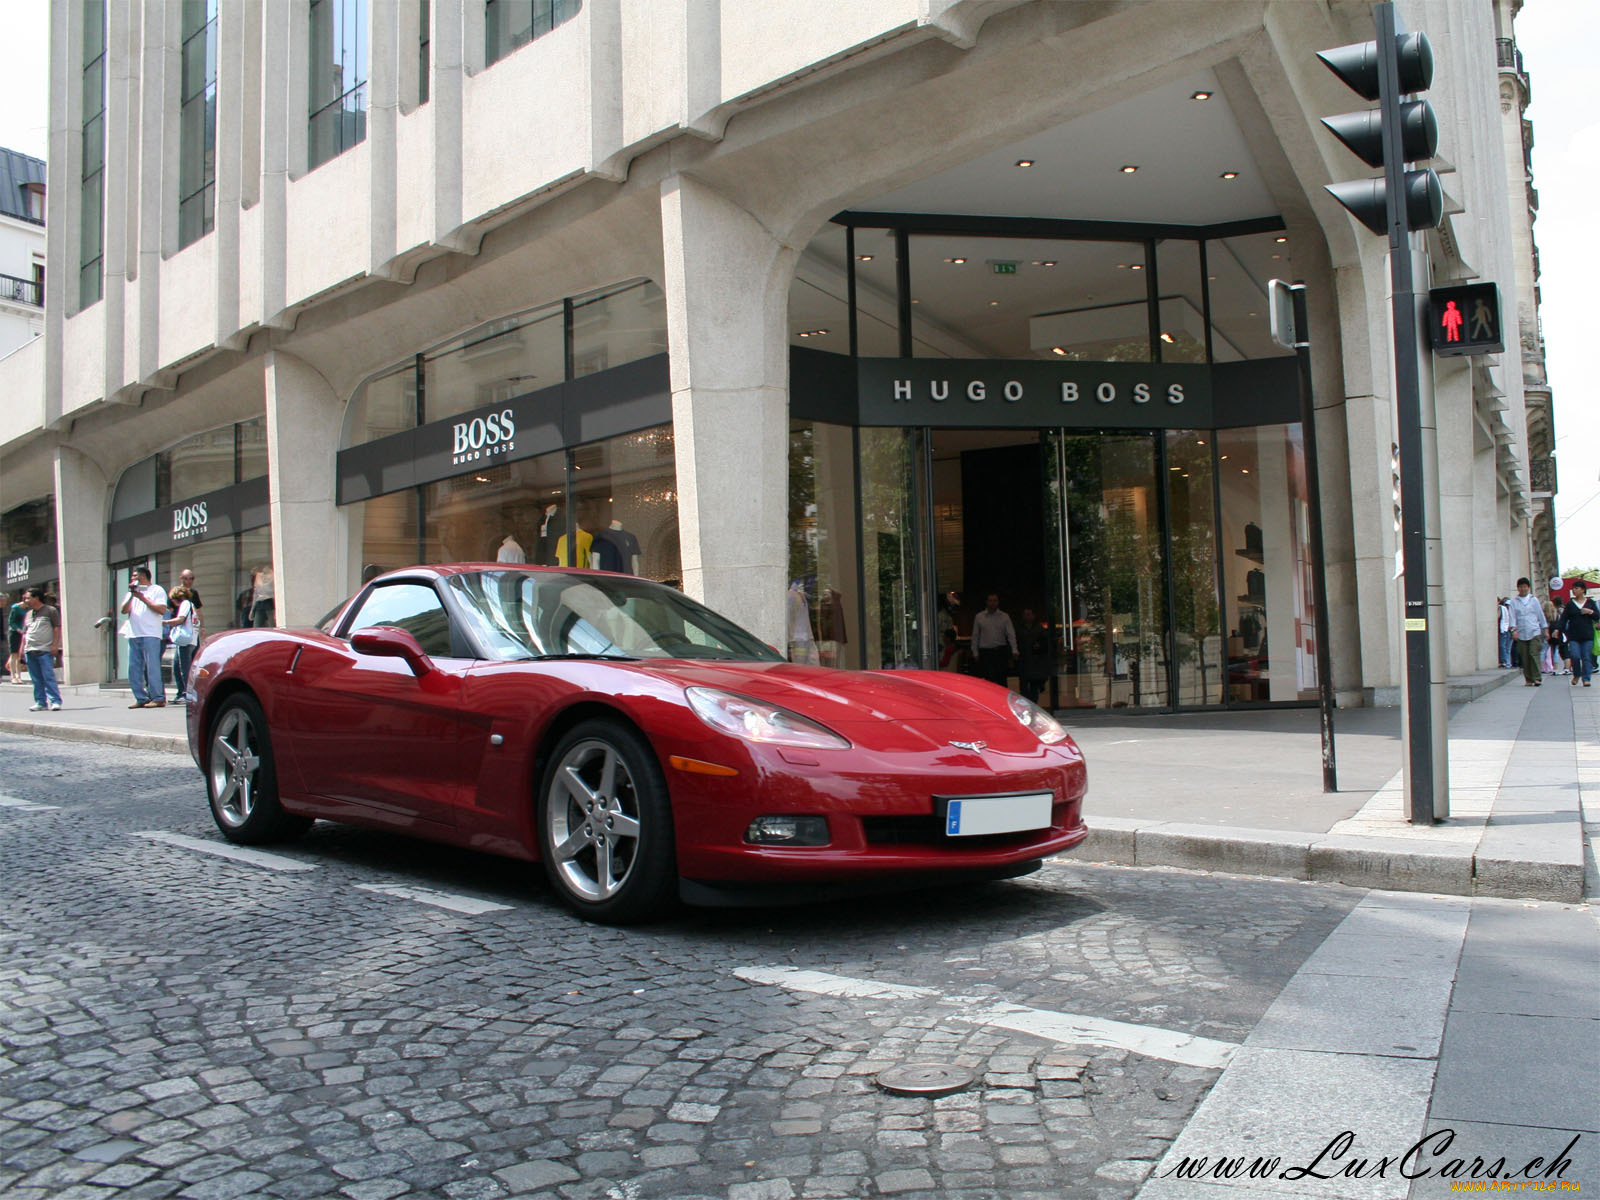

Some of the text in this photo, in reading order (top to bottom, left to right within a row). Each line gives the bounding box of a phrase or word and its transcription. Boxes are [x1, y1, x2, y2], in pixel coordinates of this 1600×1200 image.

[893, 380, 1185, 404] HUGO BOSS
[452, 409, 515, 455] BOSS
[453, 441, 515, 465] HUGO BOSS
[173, 501, 208, 533] BOSS
[7, 555, 30, 579] HUGO
